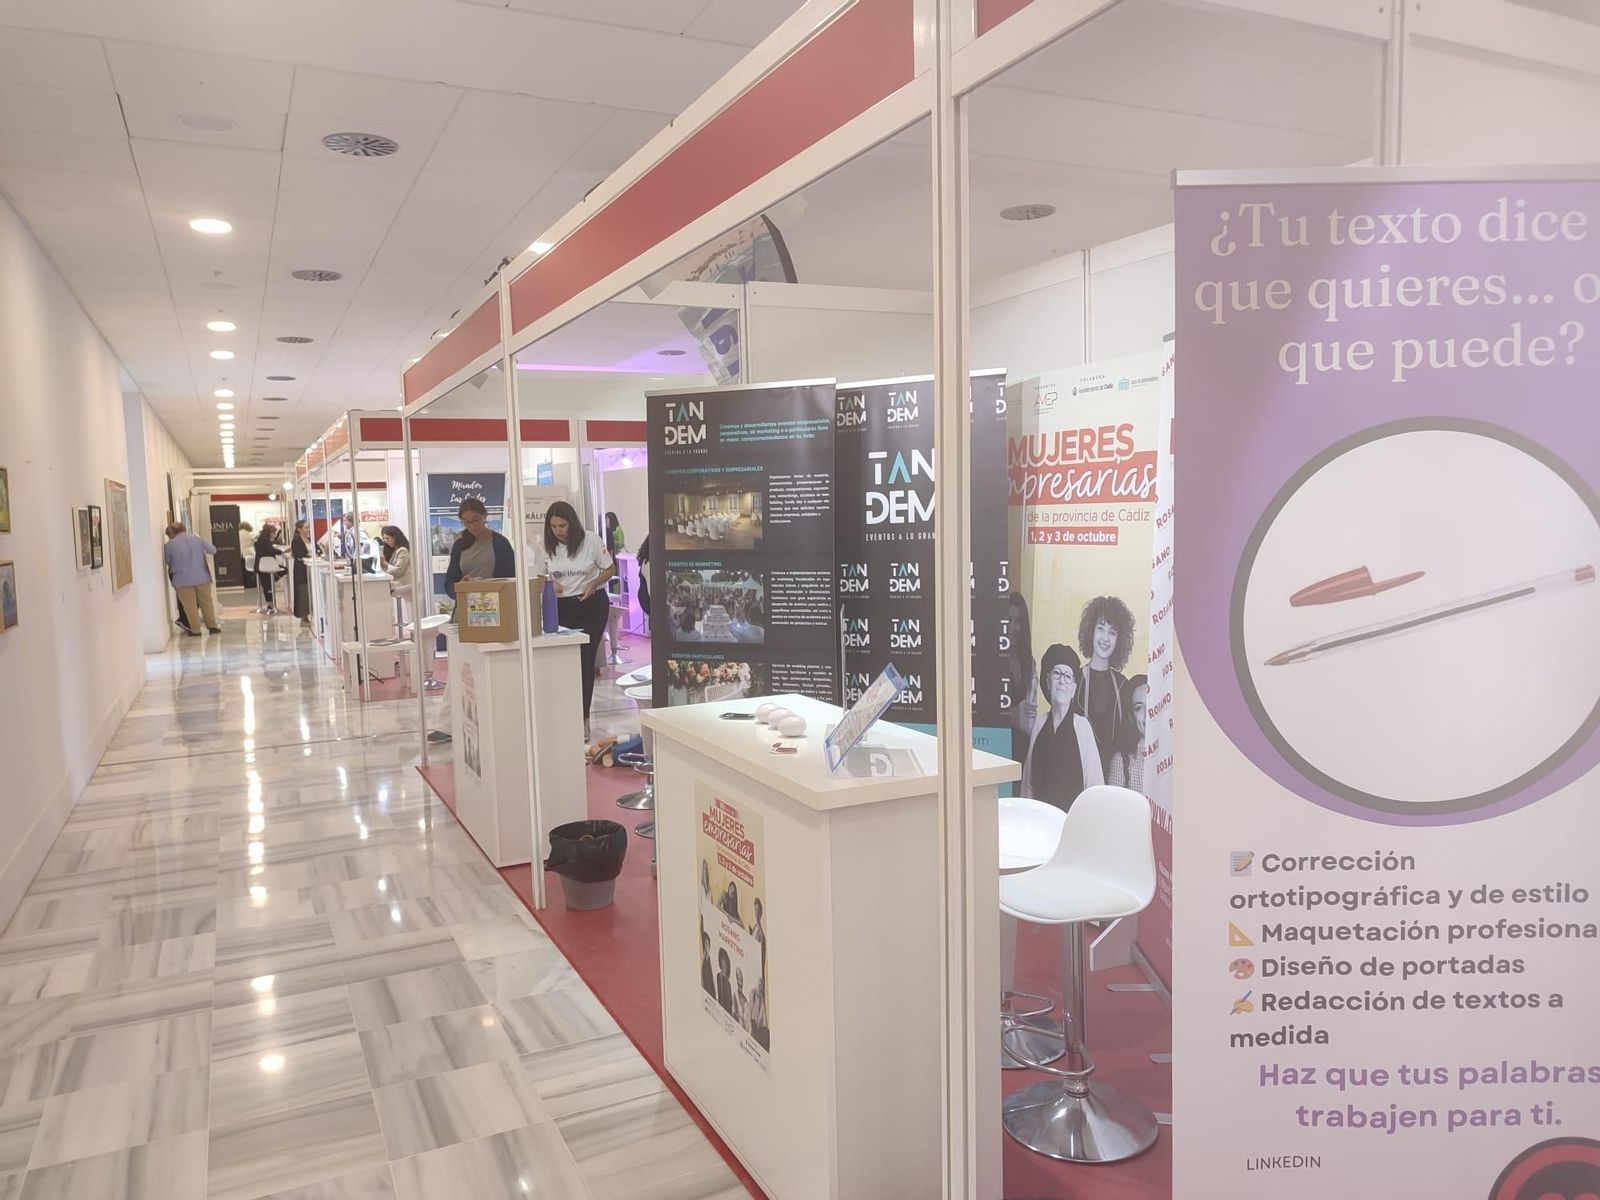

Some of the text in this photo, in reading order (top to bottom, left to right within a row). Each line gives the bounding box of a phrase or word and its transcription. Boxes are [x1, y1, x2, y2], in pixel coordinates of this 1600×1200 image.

[1210, 196, 1588, 256] ¿Tu texto dice
[1194, 278, 1292, 324] que
[1308, 264, 1554, 322] quieres...
[1278, 320, 1586, 386] que puede?
[838, 394, 865, 410] TAN
[889, 390, 917, 406] TAN
[665, 401, 704, 422] TAN
[837, 411, 866, 427] DEM
[887, 407, 918, 422] DEM
[665, 424, 706, 446] DEM
[1008, 423, 1134, 466] MUJERES
[868, 448, 935, 485] TAN
[452, 480, 483, 491] Mirador
[866, 490, 935, 524] DEM
[1028, 508, 1150, 525] de la provincia de Cádiz
[866, 533, 895, 541] EVENTOS
[1039, 532, 1044, 541] 2
[1046, 534, 1052, 543] y
[1055, 531, 1060, 541] 3
[1063, 531, 1075, 542] de
[1077, 532, 1116, 542] octubre
[841, 563, 867, 577] TAN
[891, 563, 919, 576] TAN
[840, 579, 868, 592] DEM
[890, 578, 920, 592] DEM
[843, 618, 868, 632] TAN
[892, 619, 919, 632] TAN
[891, 634, 921, 648] DEM
[1148, 693, 1171, 719] ROSANO
[710, 806, 745, 840] MUJERES
[1262, 850, 1416, 873] Corrección
[1230, 881, 1589, 911] ortotipográfica y de estilo
[1262, 917, 1599, 945] Maquetación profesiona
[718, 931, 744, 958] MARKETING
[1262, 954, 1525, 980] Diseño de portadas
[1262, 988, 1564, 1012] Redacción de textos a
[1230, 1024, 1329, 1048] medida
[1259, 1060, 1600, 1091] Haz que tus palabras
[1296, 1101, 1563, 1135] trabajen para ti.
[1247, 1155, 1321, 1170] LINKEDIN
